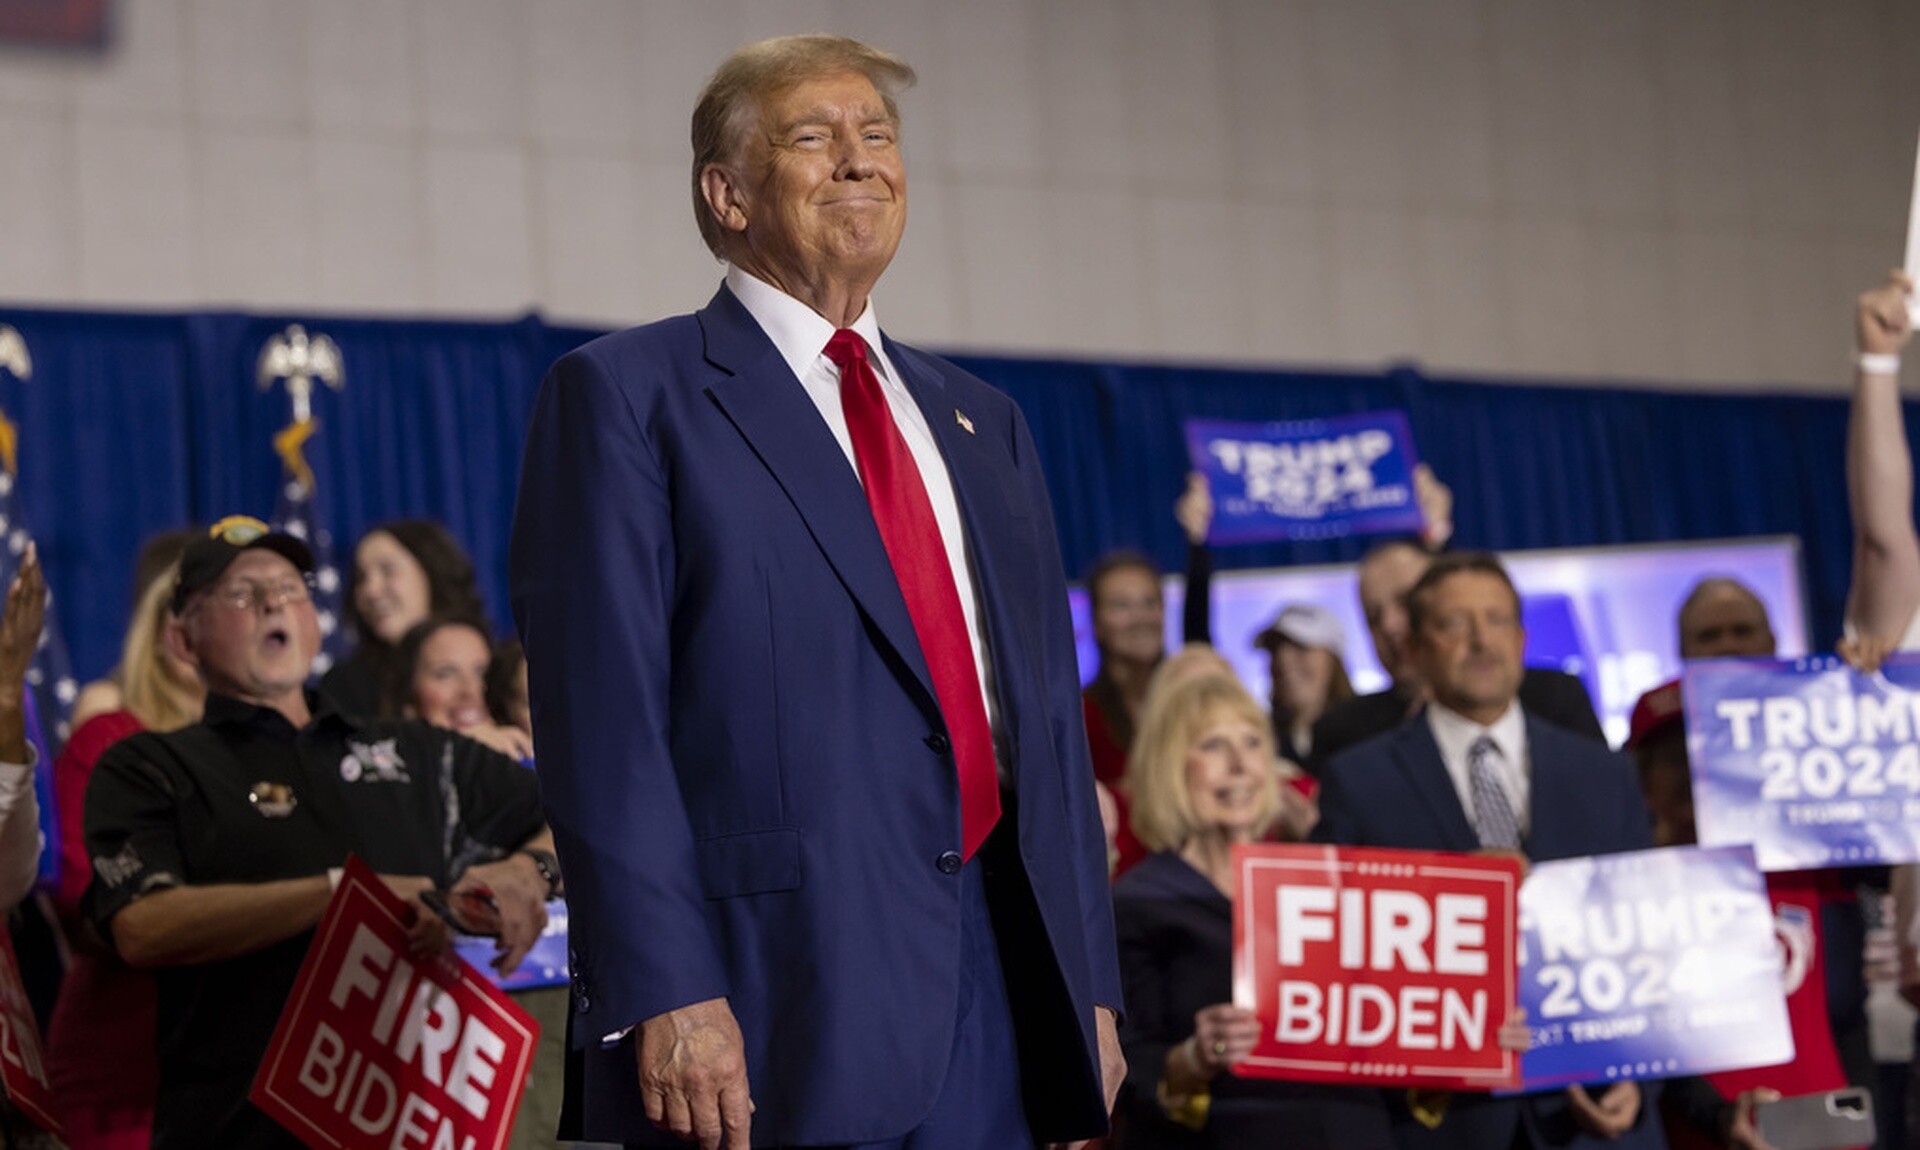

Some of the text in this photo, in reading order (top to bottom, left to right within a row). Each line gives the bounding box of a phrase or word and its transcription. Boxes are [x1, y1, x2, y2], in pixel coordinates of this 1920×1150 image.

[1760, 745, 1920, 801] 2024
[1275, 884, 1489, 976] FIRE
[1518, 894, 1740, 966] RUMP
[329, 922, 506, 1121] FIRE
[1274, 979, 1489, 1051] BIDEN
